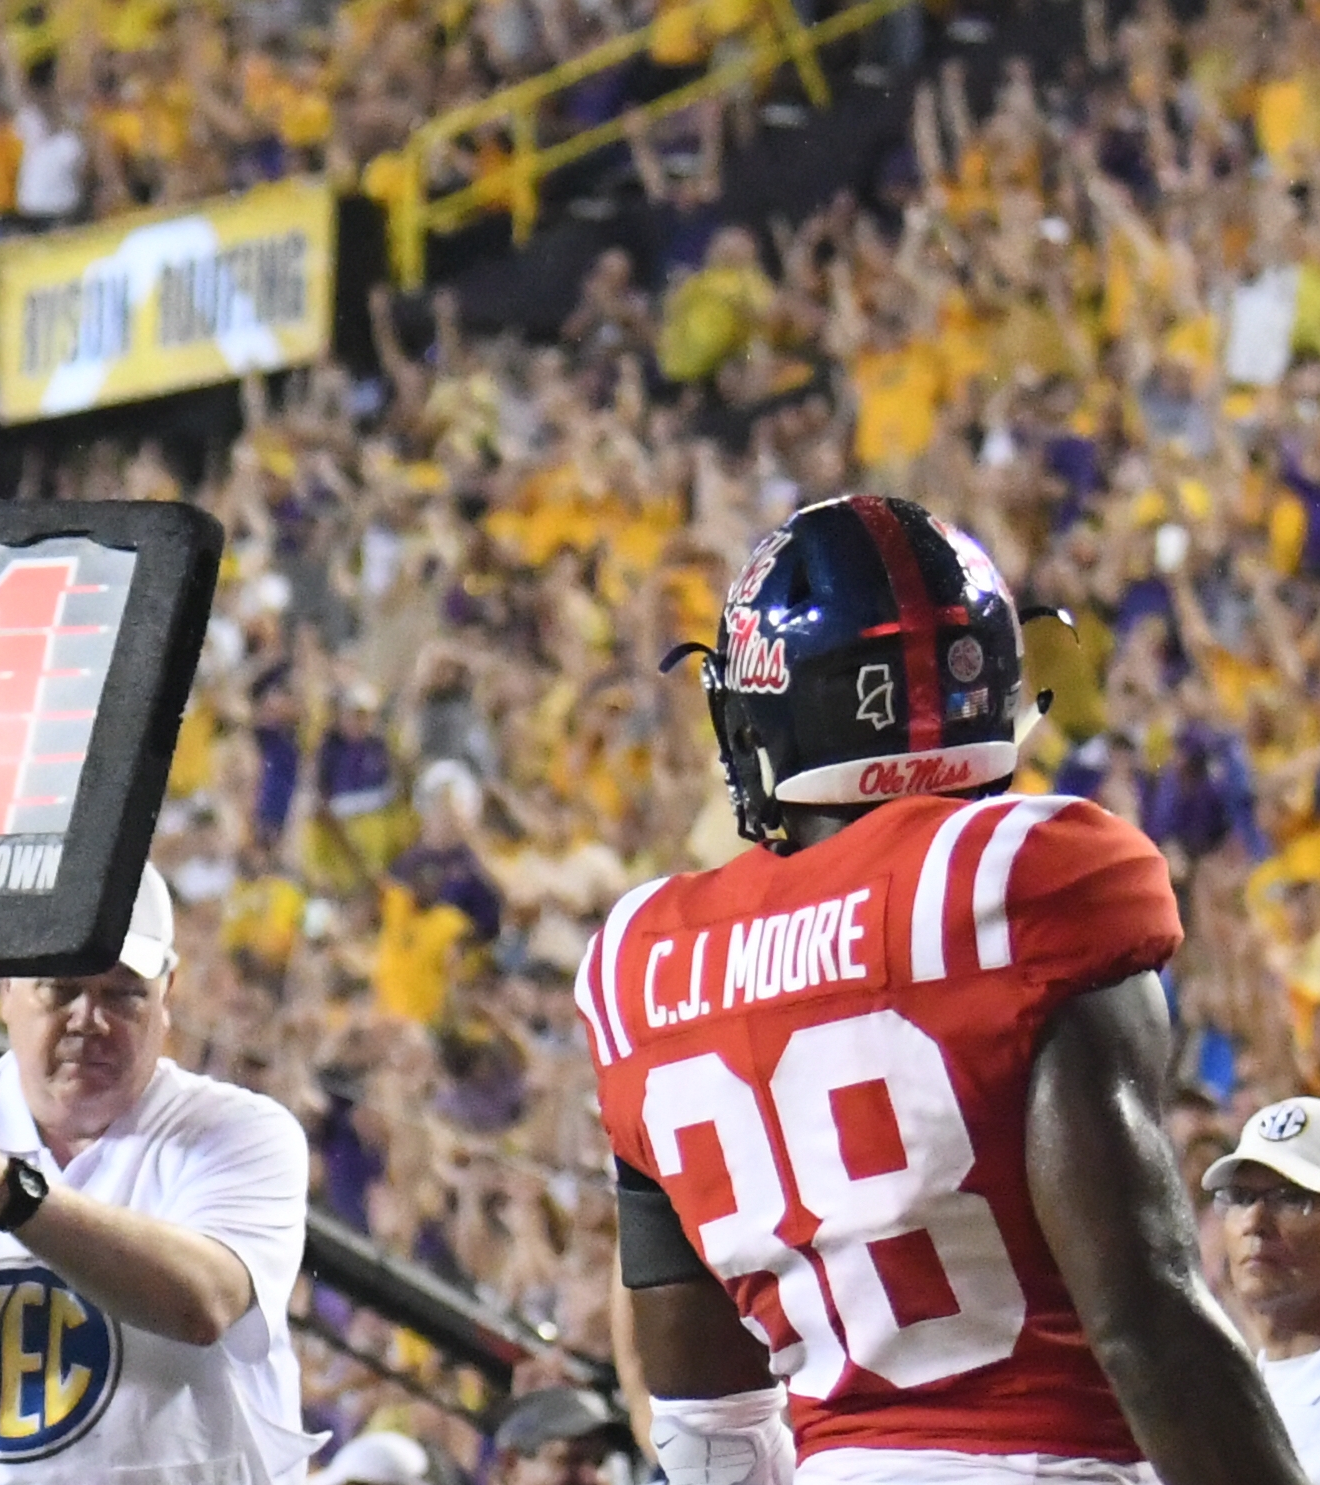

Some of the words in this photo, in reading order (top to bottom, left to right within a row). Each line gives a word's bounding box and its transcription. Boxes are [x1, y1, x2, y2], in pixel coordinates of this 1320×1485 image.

[724, 603, 790, 694] Miss
[859, 763, 904, 796] Ole
[905, 756, 972, 793] Miss
[644, 931, 710, 1029] C.J.
[722, 888, 870, 1009] MOORE
[642, 1009, 1027, 1400] 38
